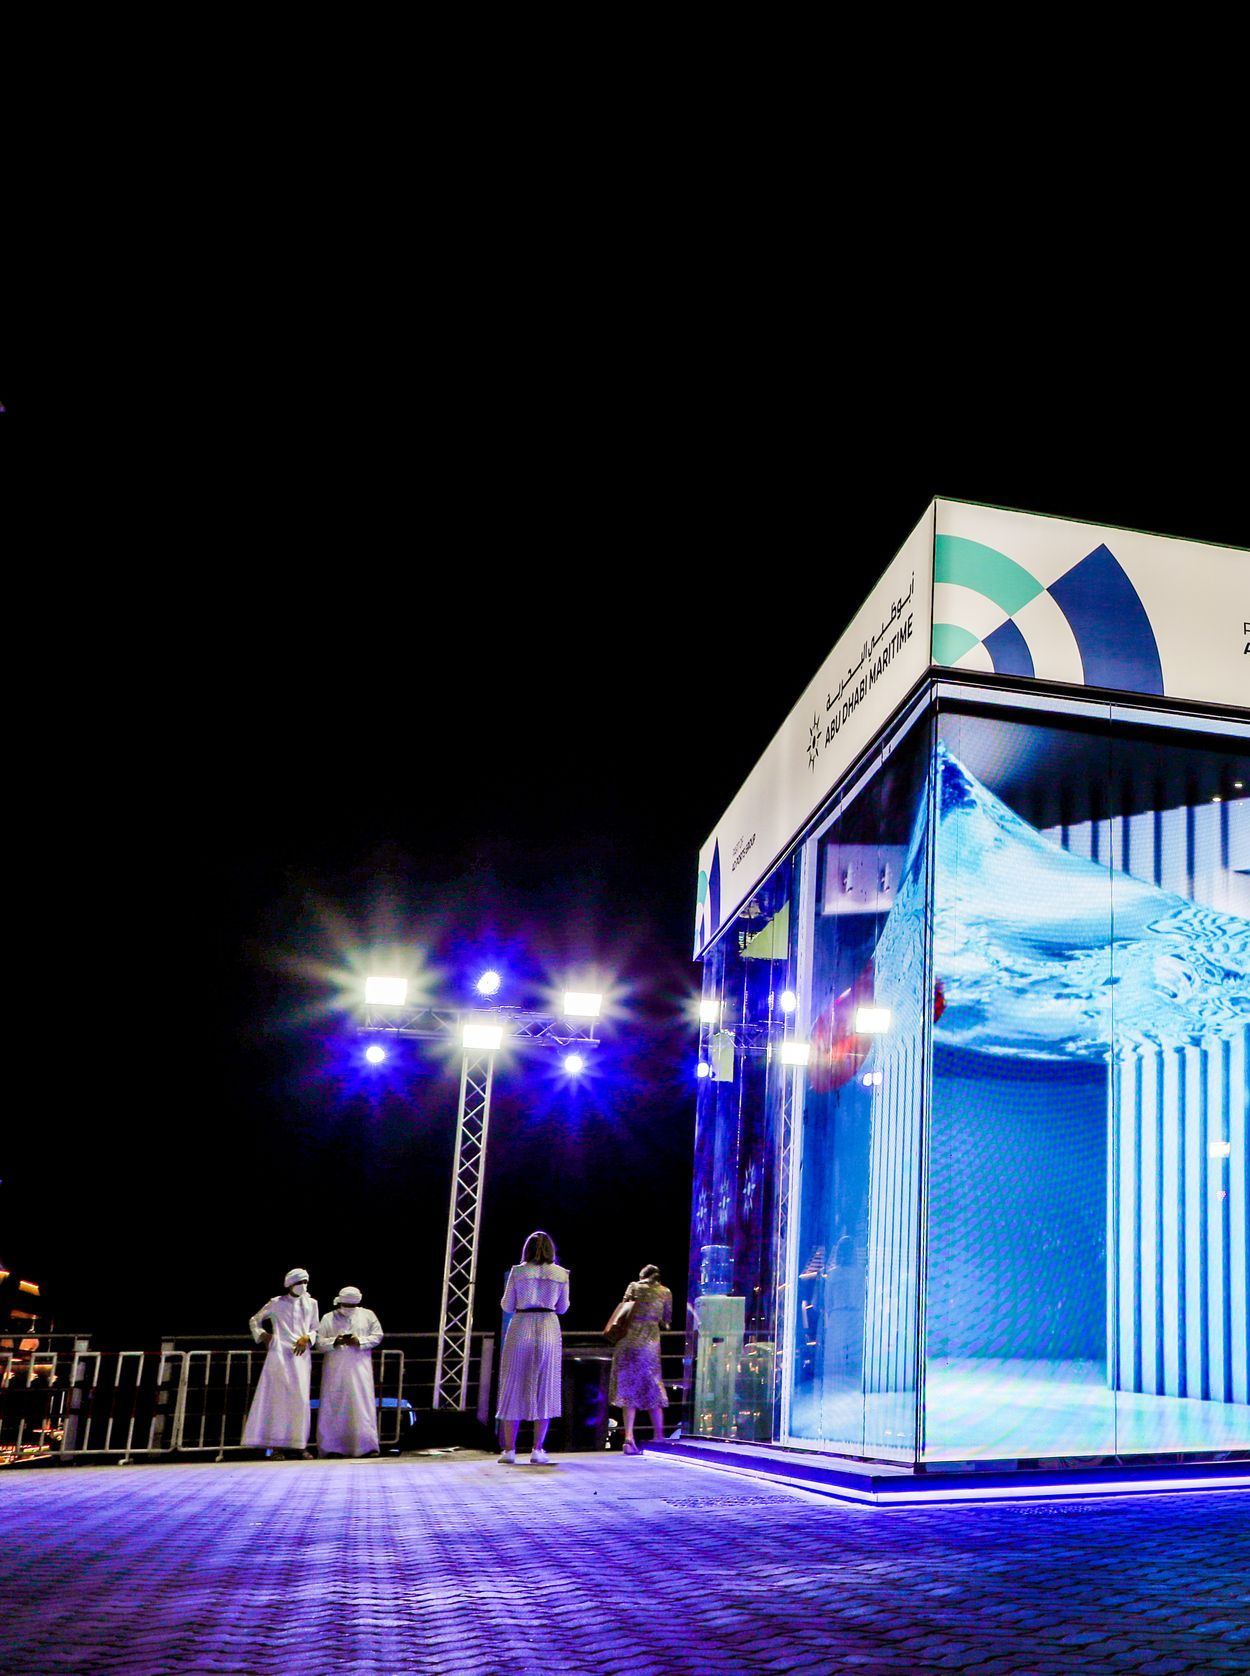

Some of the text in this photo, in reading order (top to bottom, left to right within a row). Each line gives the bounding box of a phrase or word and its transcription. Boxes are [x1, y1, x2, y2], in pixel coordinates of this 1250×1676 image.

[825, 612, 914, 748] ABU DHABI MARITIME
